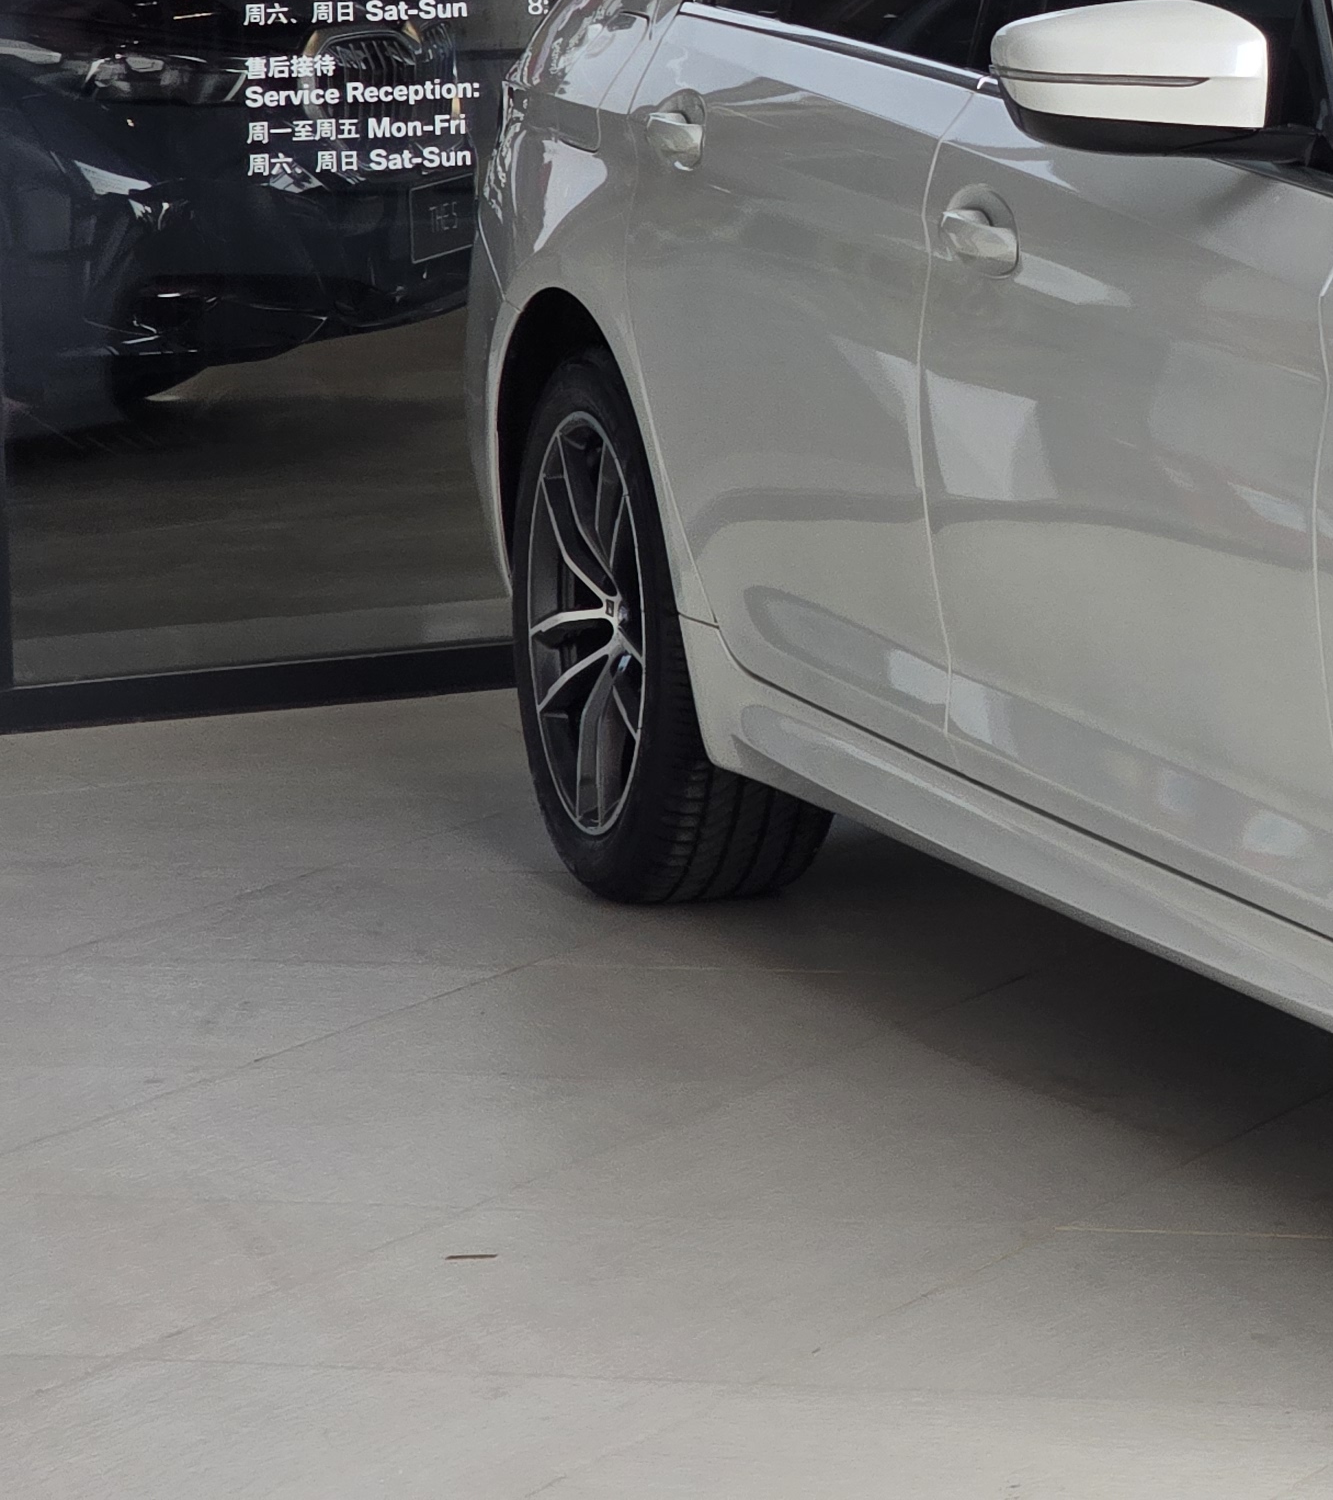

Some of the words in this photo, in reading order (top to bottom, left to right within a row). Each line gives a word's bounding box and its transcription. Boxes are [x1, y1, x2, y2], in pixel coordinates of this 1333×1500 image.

[245, 54, 337, 80] 售后接待
[245, 85, 341, 108] Service
[346, 78, 480, 105] Reception:
[246, 118, 361, 144] 周一至周五
[367, 112, 466, 139] Mon-Fri
[369, 145, 472, 171] Sat-Sun
